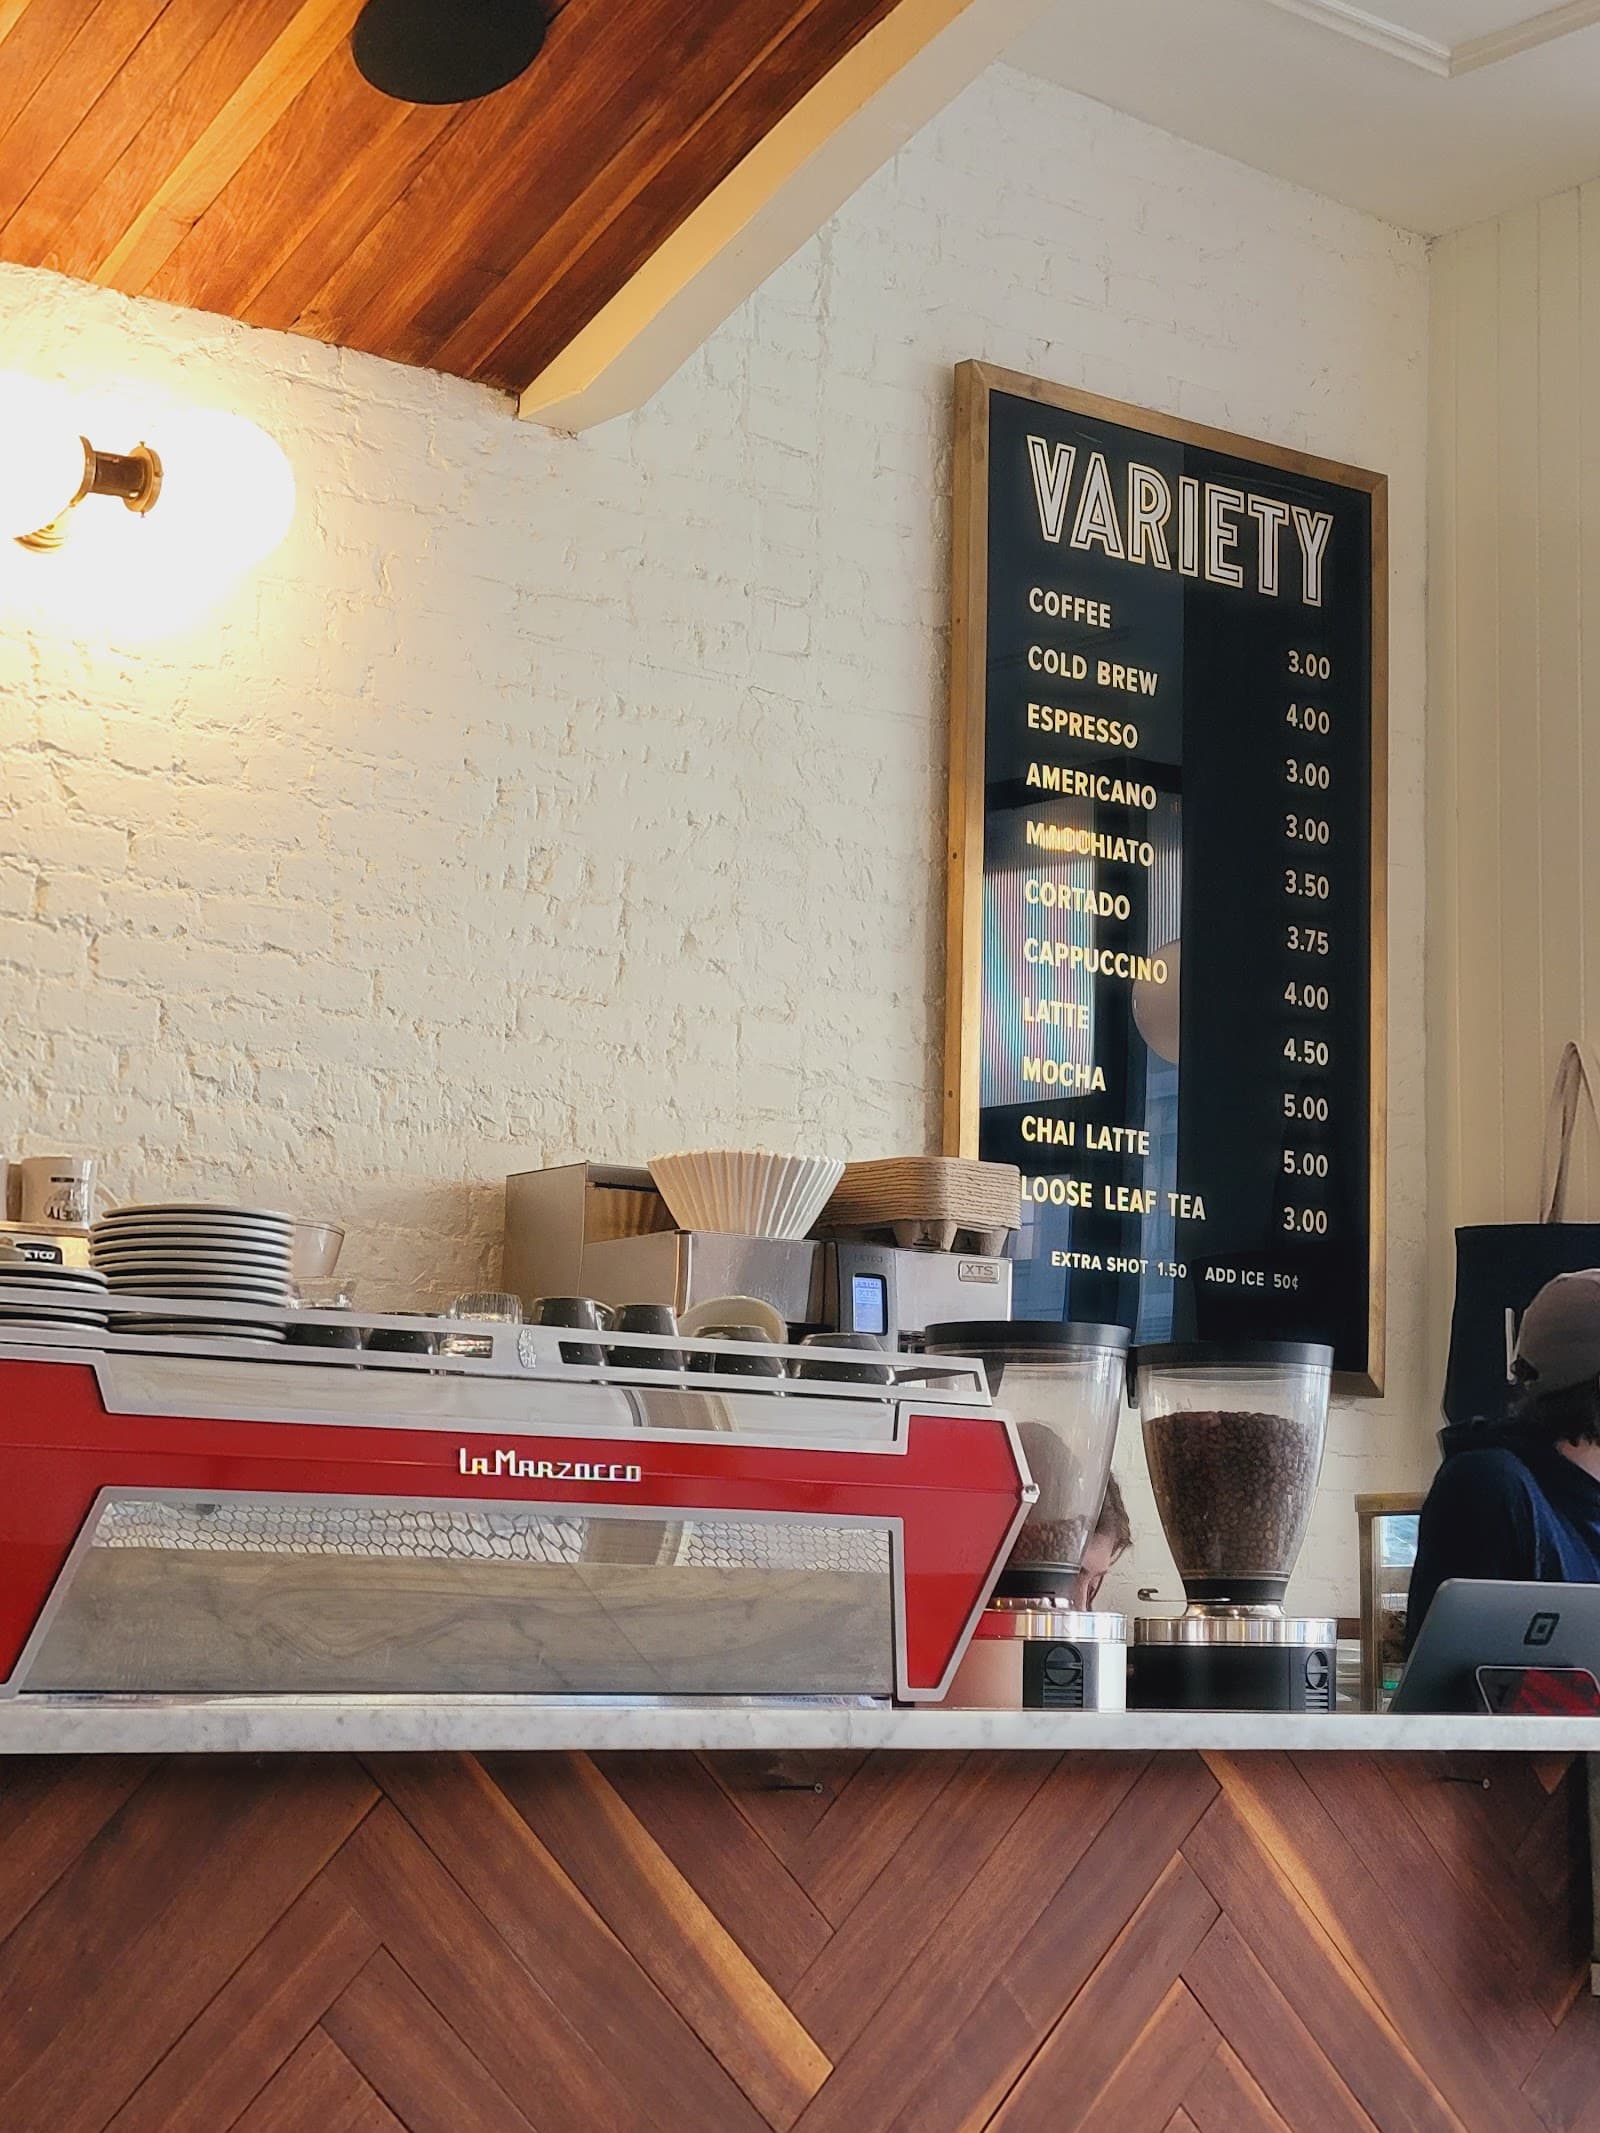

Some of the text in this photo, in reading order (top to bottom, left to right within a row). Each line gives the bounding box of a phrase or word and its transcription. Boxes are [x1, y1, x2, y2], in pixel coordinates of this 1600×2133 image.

[1026, 434, 1334, 607] VARIETY
[1028, 587, 1331, 680] COFFEE 3.00
[1027, 645, 1330, 735] COLD BREW 4.00
[1027, 703, 1330, 790] ESPRESSO 3.00
[1026, 762, 1330, 845] AMERICANO 3.00
[1026, 821, 1330, 900] MACCHIATO 3.50
[1025, 879, 1329, 955] CORTADO 3.75
[1024, 938, 1329, 1011] CAPPUCCINO 4.00
[1023, 996, 1329, 1067] LATTE 4.50
[1023, 1056, 1329, 1122] MOCHA 5.00
[1021, 1115, 1328, 1178] CHAI LATTE 5.00
[1021, 1175, 1328, 1235] LOOSE LEAF TEA 3.00
[965, 1264, 994, 1276] XTS
[1051, 1250, 1299, 1291] EXTRA SHOT 1.50 ADD ICE 50¢
